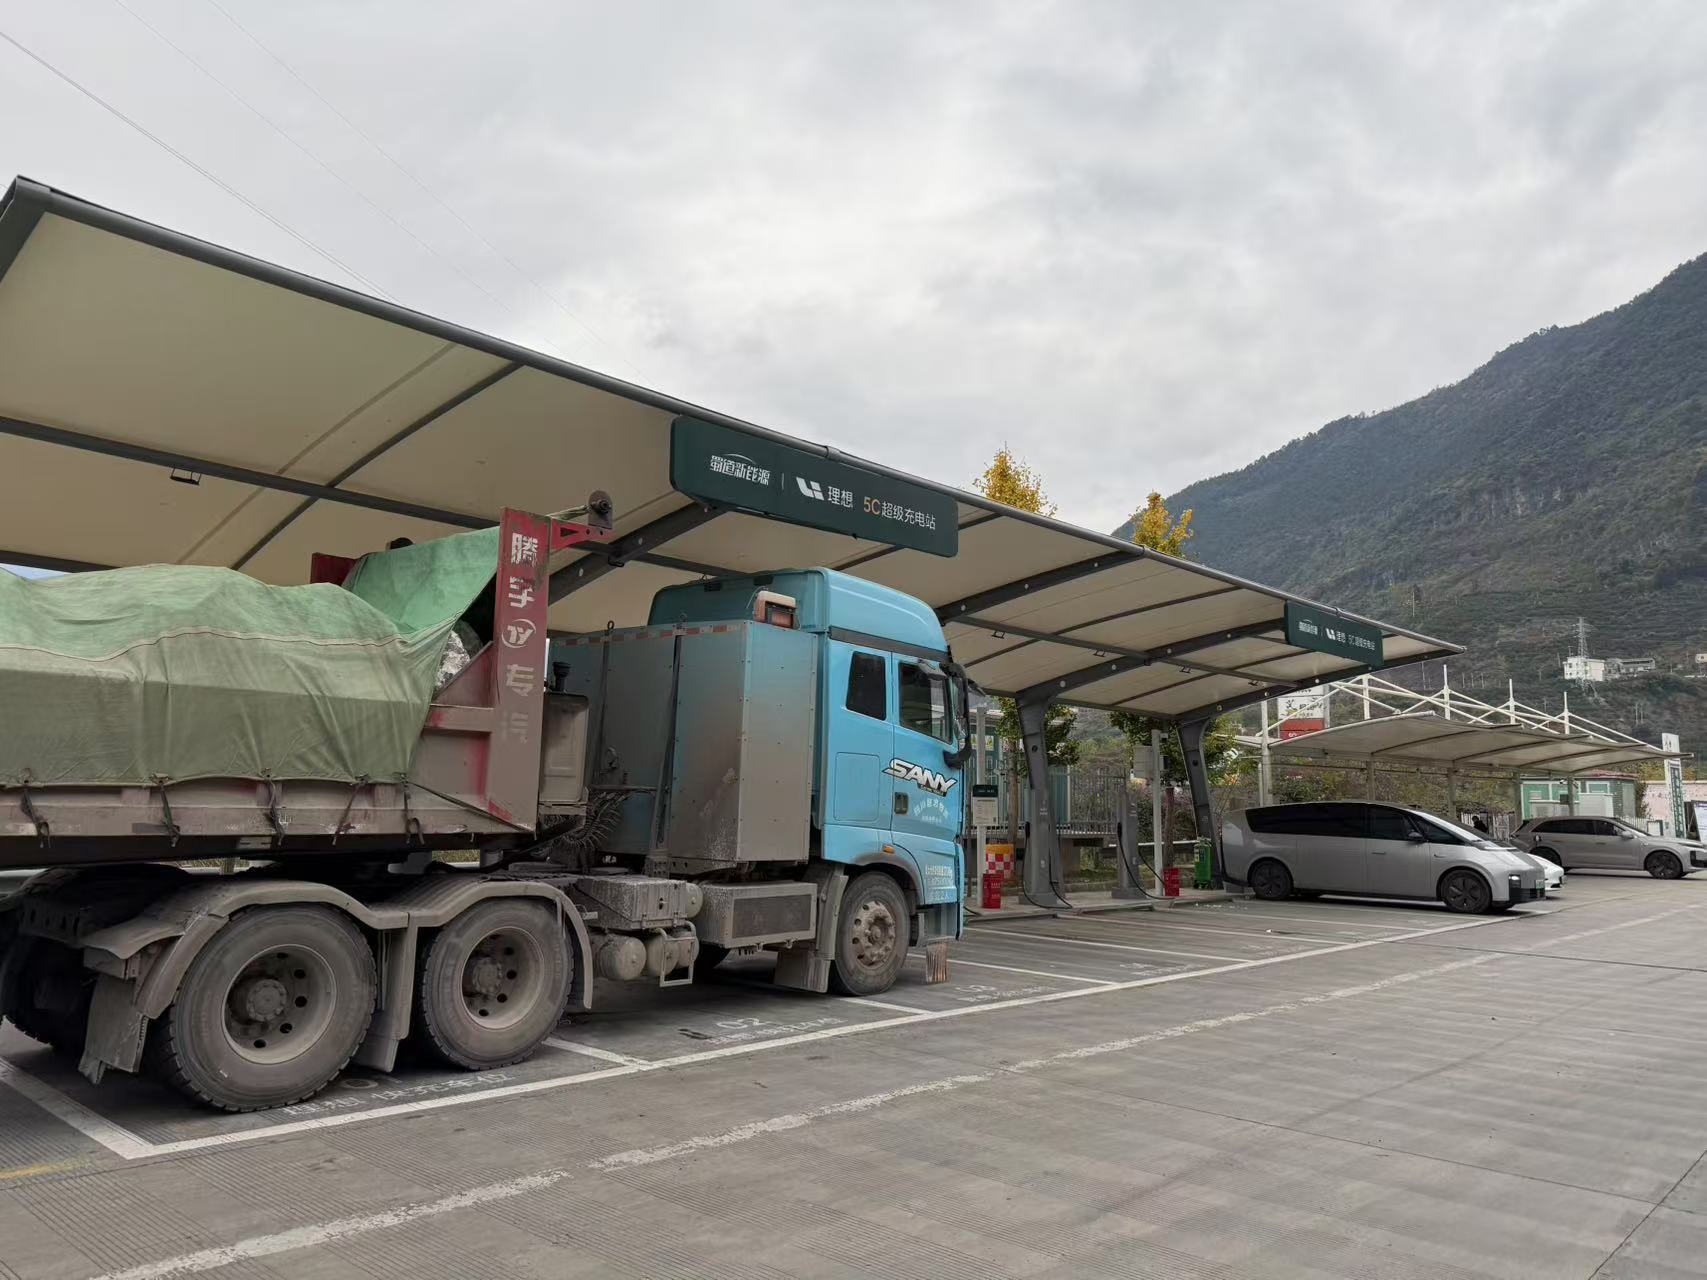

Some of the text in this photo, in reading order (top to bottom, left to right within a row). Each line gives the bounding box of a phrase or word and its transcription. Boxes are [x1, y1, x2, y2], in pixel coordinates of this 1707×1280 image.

[710, 455, 936, 530] 蜀道新能源 理想 5C超级充电站
[885, 758, 957, 792] SANY
[716, 1017, 766, 1029] 02
